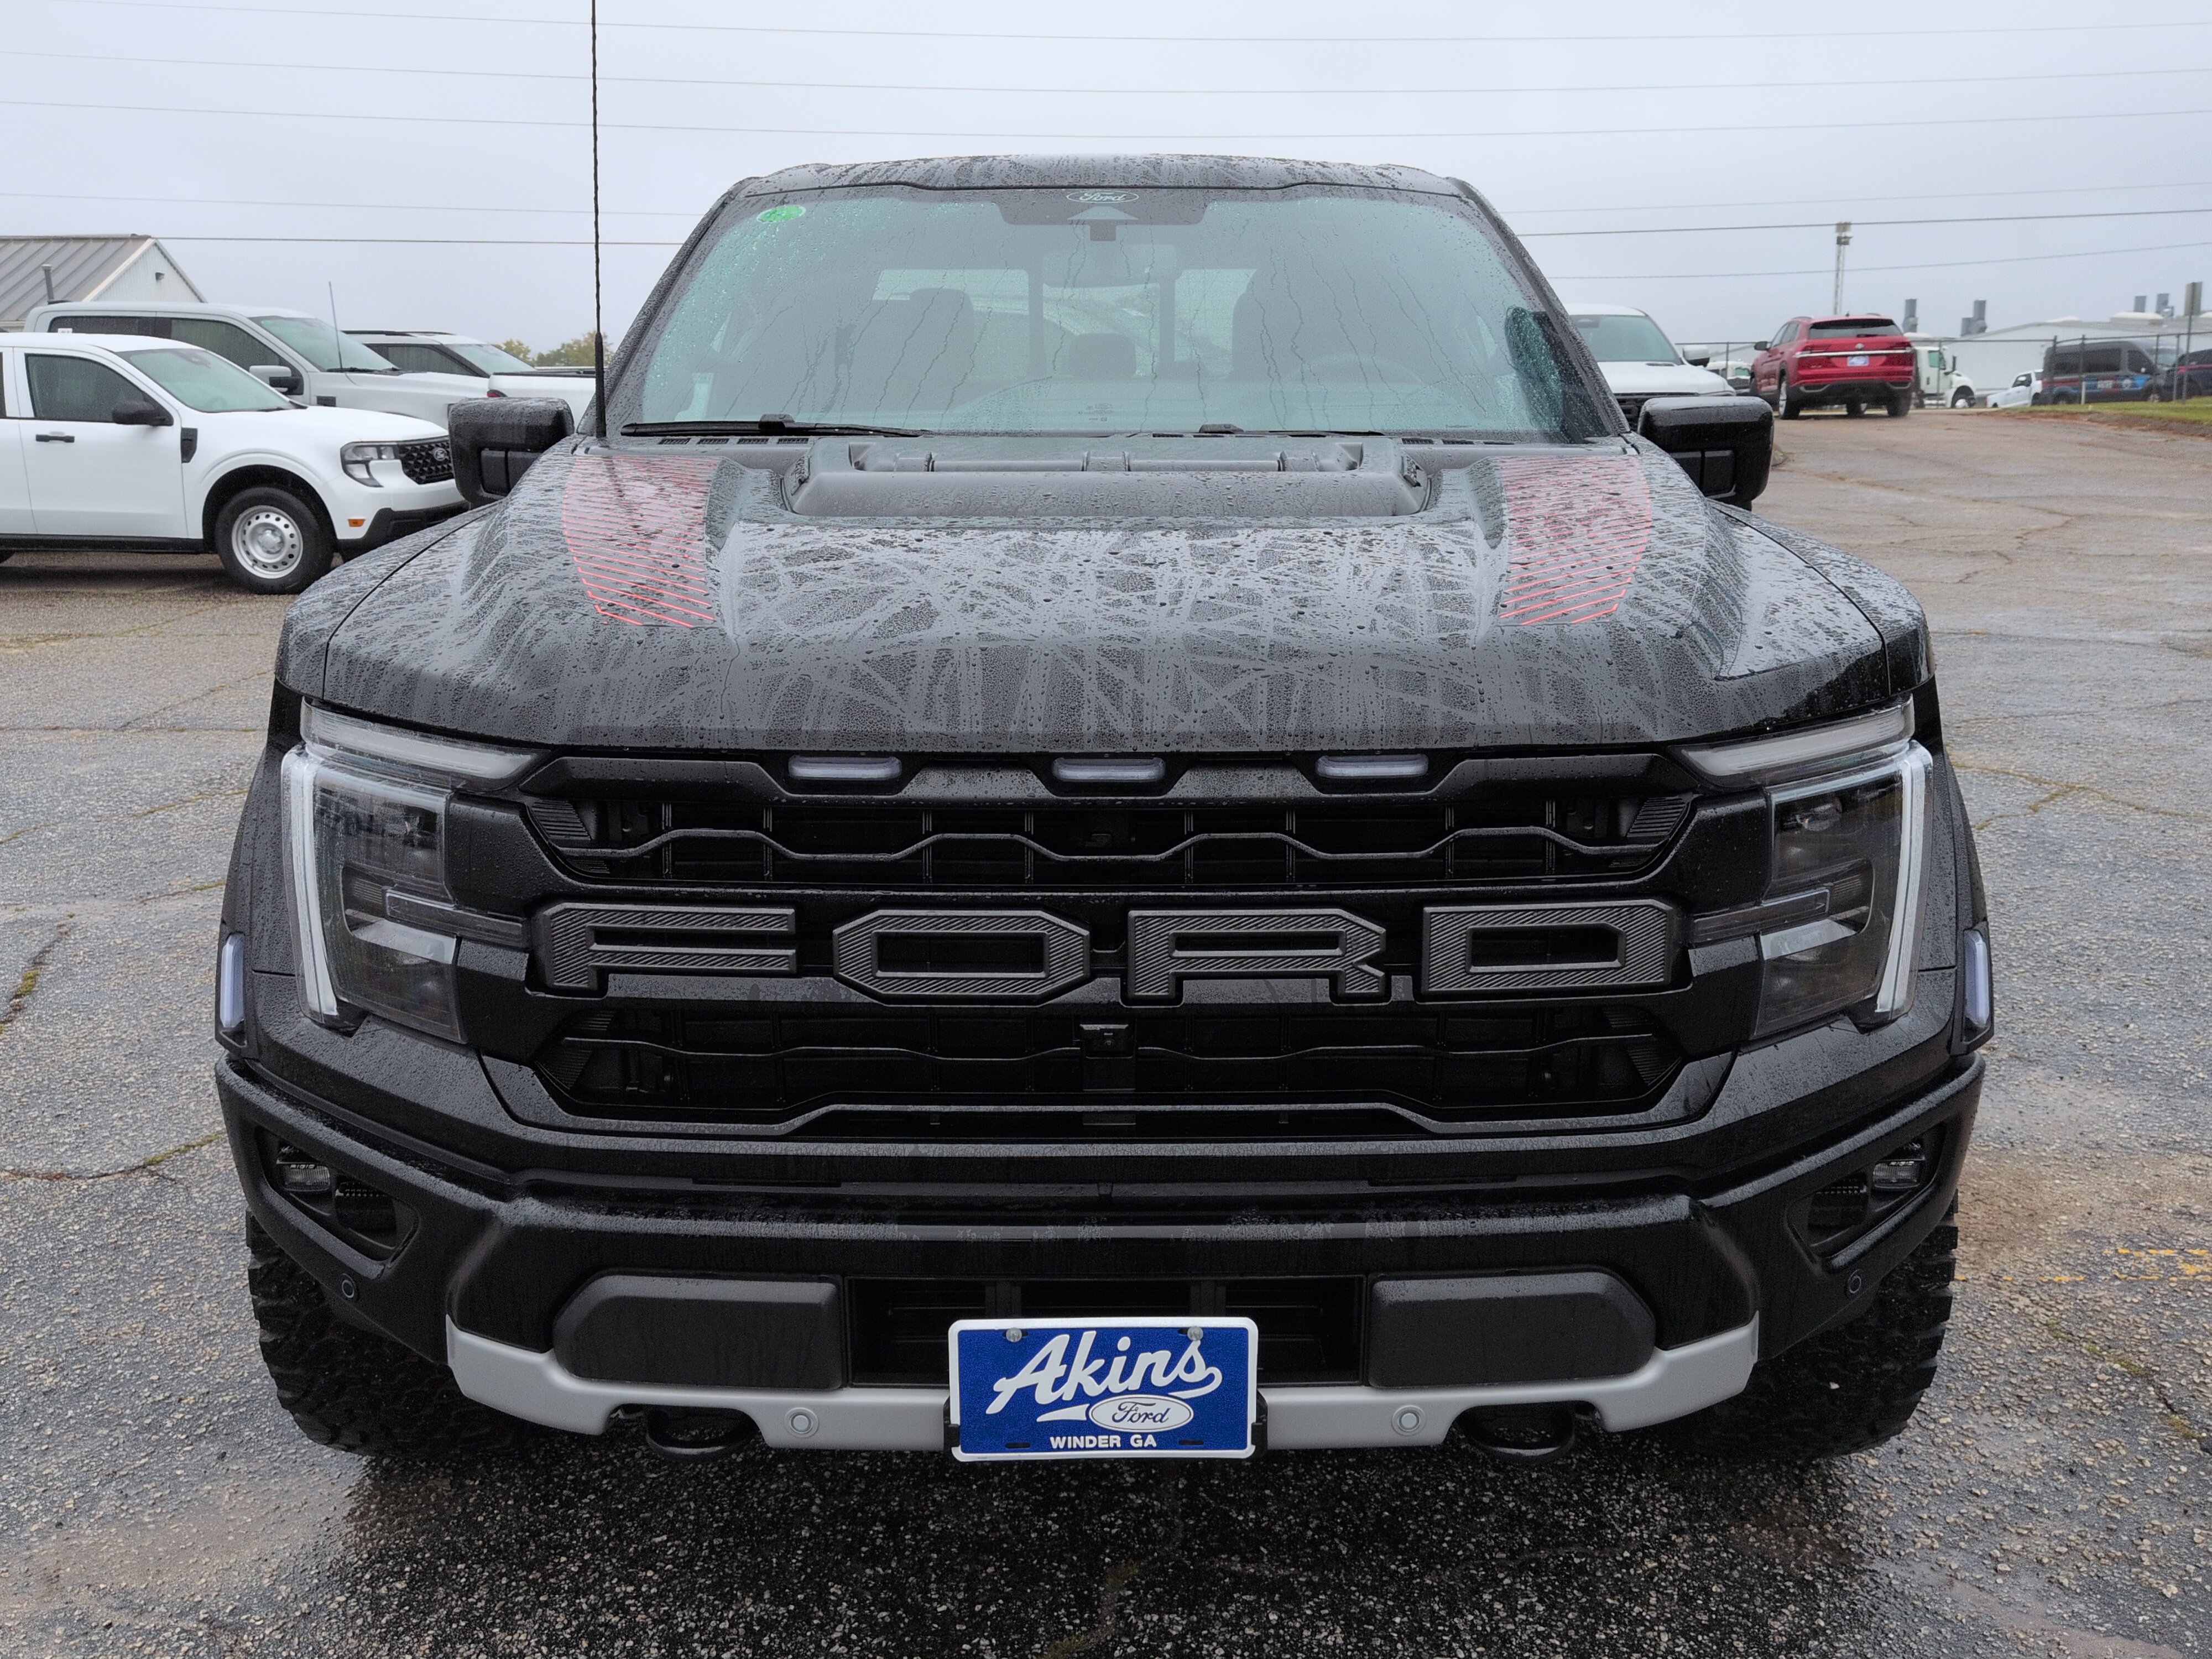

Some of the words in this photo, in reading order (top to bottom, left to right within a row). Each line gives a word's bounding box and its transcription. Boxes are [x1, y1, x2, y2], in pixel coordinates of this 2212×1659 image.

[1079, 192, 1127, 201] Ford
[540, 899, 1673, 999] FORD
[985, 1331, 1223, 1415] Akins
[1112, 1401, 1171, 1423] Ford
[1050, 1434, 1121, 1449] WINDER
[1130, 1434, 1157, 1447] GA
